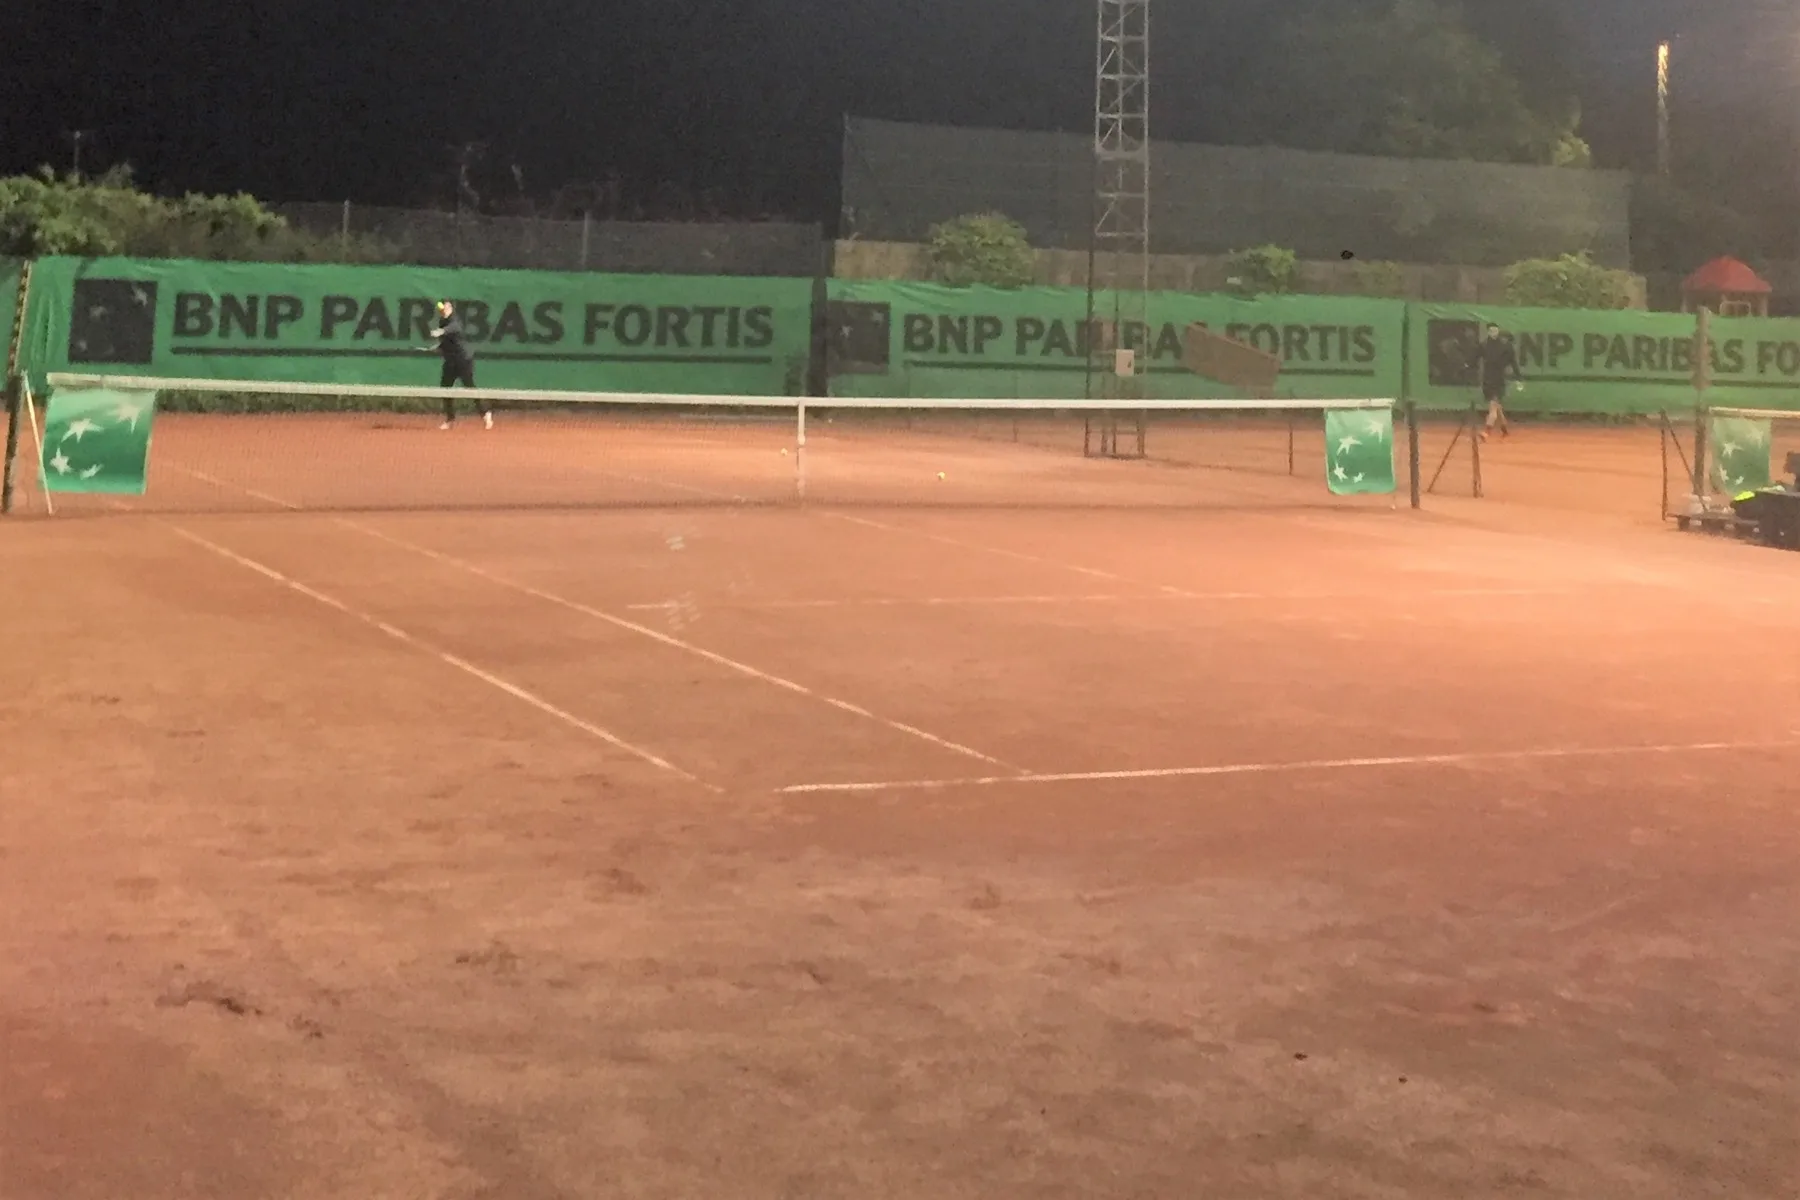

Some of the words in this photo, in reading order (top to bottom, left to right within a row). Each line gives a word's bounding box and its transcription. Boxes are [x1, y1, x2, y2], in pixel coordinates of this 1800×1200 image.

[173, 292, 303, 340] BNP
[320, 295, 565, 344] PARBAS
[583, 303, 774, 349] FORTIS
[903, 313, 1002, 355] BNP
[1015, 316, 1207, 360] PABA
[1499, 330, 1574, 368] NP
